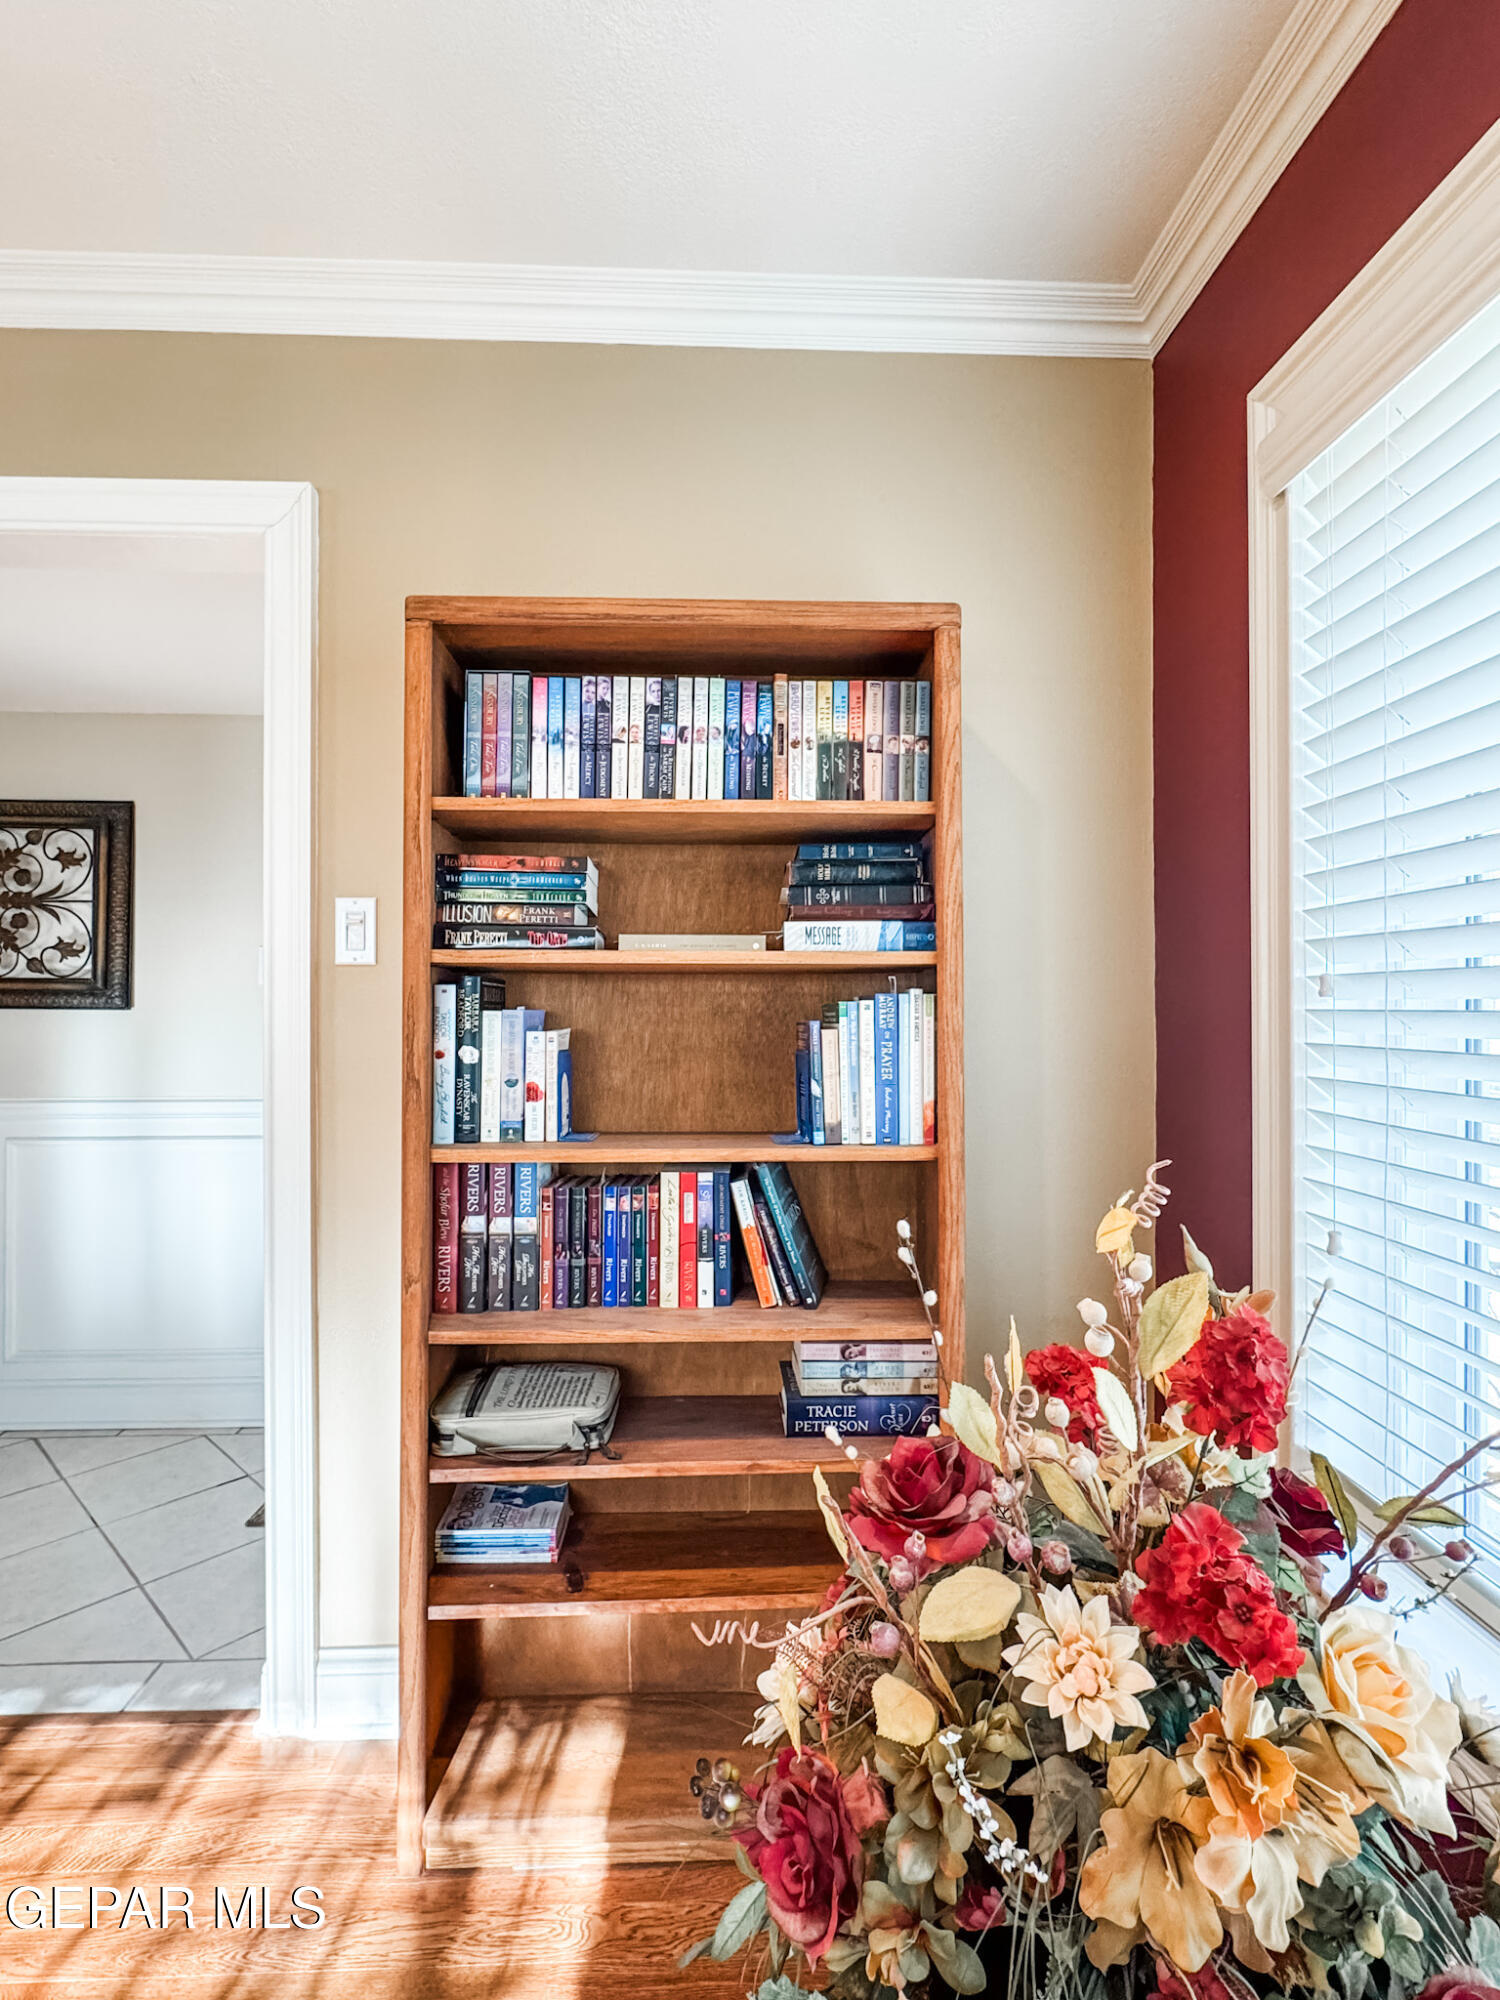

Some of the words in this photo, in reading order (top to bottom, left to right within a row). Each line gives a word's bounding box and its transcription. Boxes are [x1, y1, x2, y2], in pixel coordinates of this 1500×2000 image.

[791, 684, 799, 712] BEVERLY
[585, 761, 593, 785] MERCY
[599, 761, 607, 797] JUDGMENT
[648, 762, 656, 788] THORN
[442, 905, 492, 923] ILLUSION
[523, 906, 555, 914] FRANK
[520, 915, 558, 923] PERETTI
[445, 930, 472, 945] FRANK
[473, 930, 508, 945] PERETTI
[805, 926, 841, 945] MESSAGE
[471, 993, 479, 1033] BARBARA
[886, 996, 895, 1029] ANDREW
[881, 1041, 892, 1080] PRAYER
[455, 1078, 463, 1116] DYNASTY
[463, 1074, 471, 1121] RAVENSCAR
[440, 1187, 450, 1216] Shofar
[467, 1164, 479, 1212] RIVERS
[493, 1167, 506, 1213] RIVERS
[520, 1167, 532, 1213] RIVERS
[439, 1219, 449, 1241] Blew
[438, 1245, 450, 1293] RIVERS
[666, 1262, 674, 1283] RIVERS
[684, 1261, 693, 1291] RIVERS
[806, 1406, 856, 1417] TRACIE
[795, 1421, 869, 1432] PETERSON
